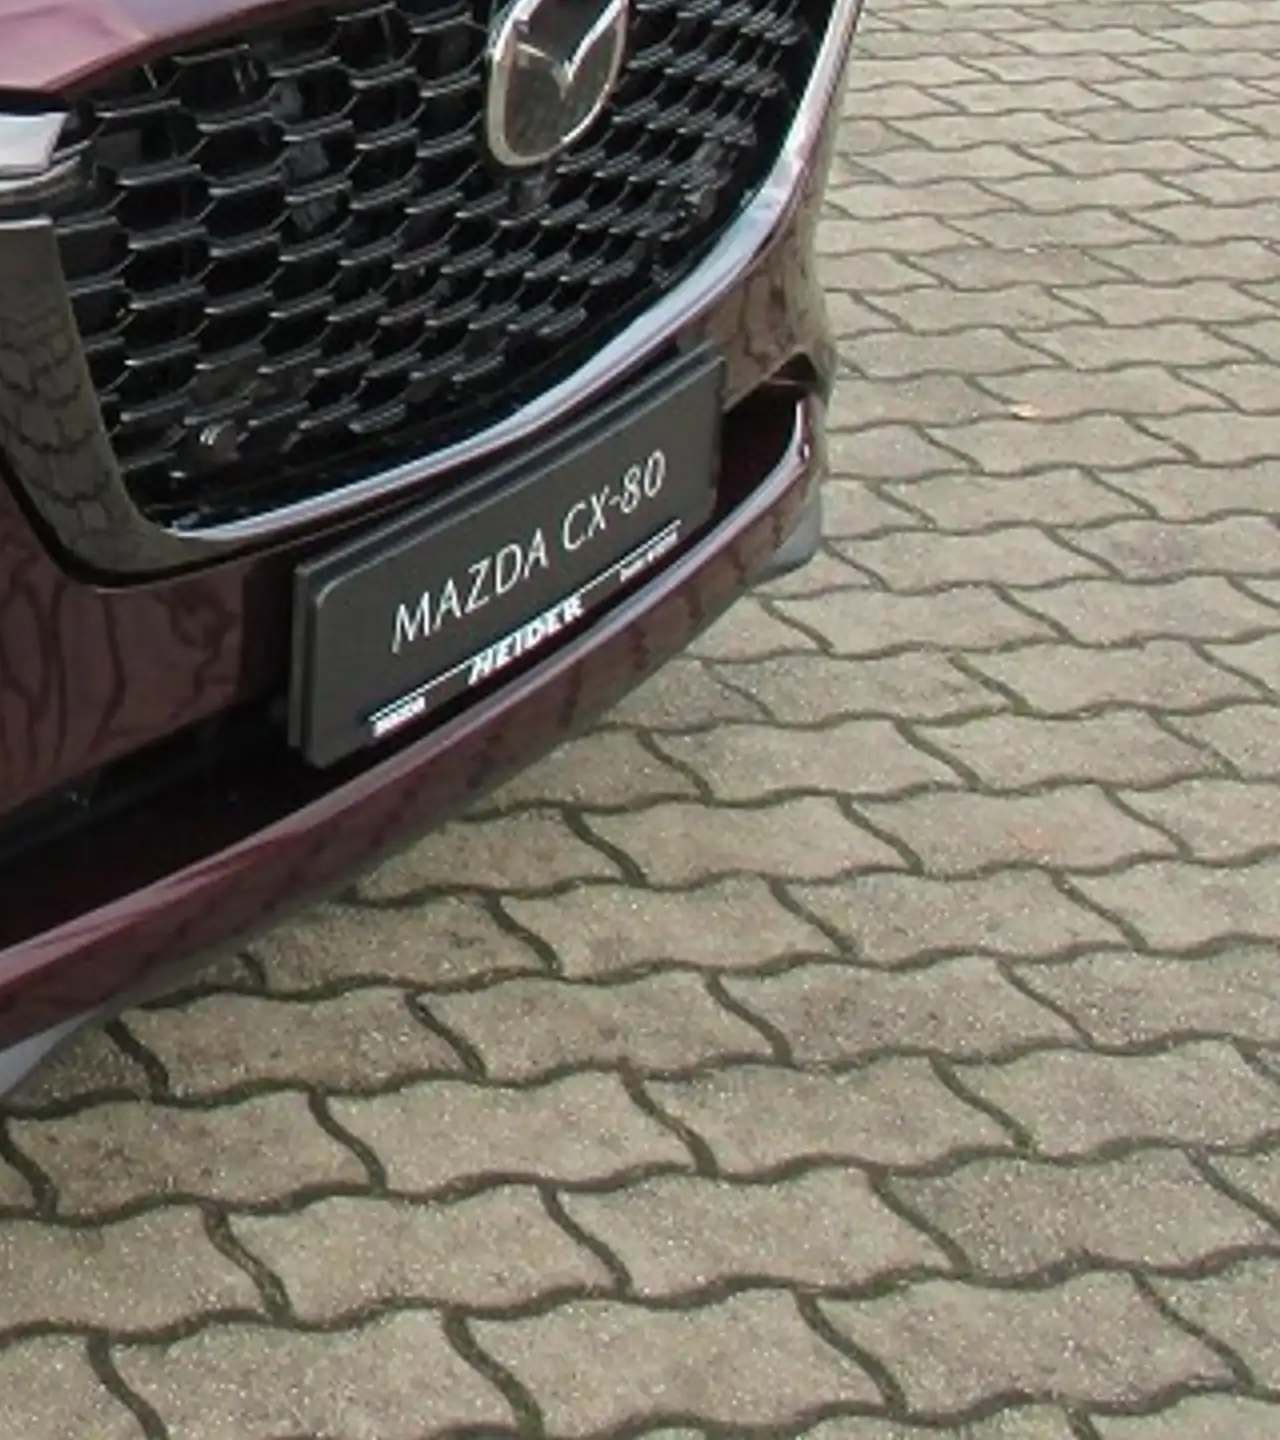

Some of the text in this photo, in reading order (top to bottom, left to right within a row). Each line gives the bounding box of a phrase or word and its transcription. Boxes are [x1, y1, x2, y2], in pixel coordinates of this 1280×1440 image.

[391, 528, 550, 655] MAZDA
[562, 449, 666, 551] CX-80
[467, 594, 584, 686] HEIDER
